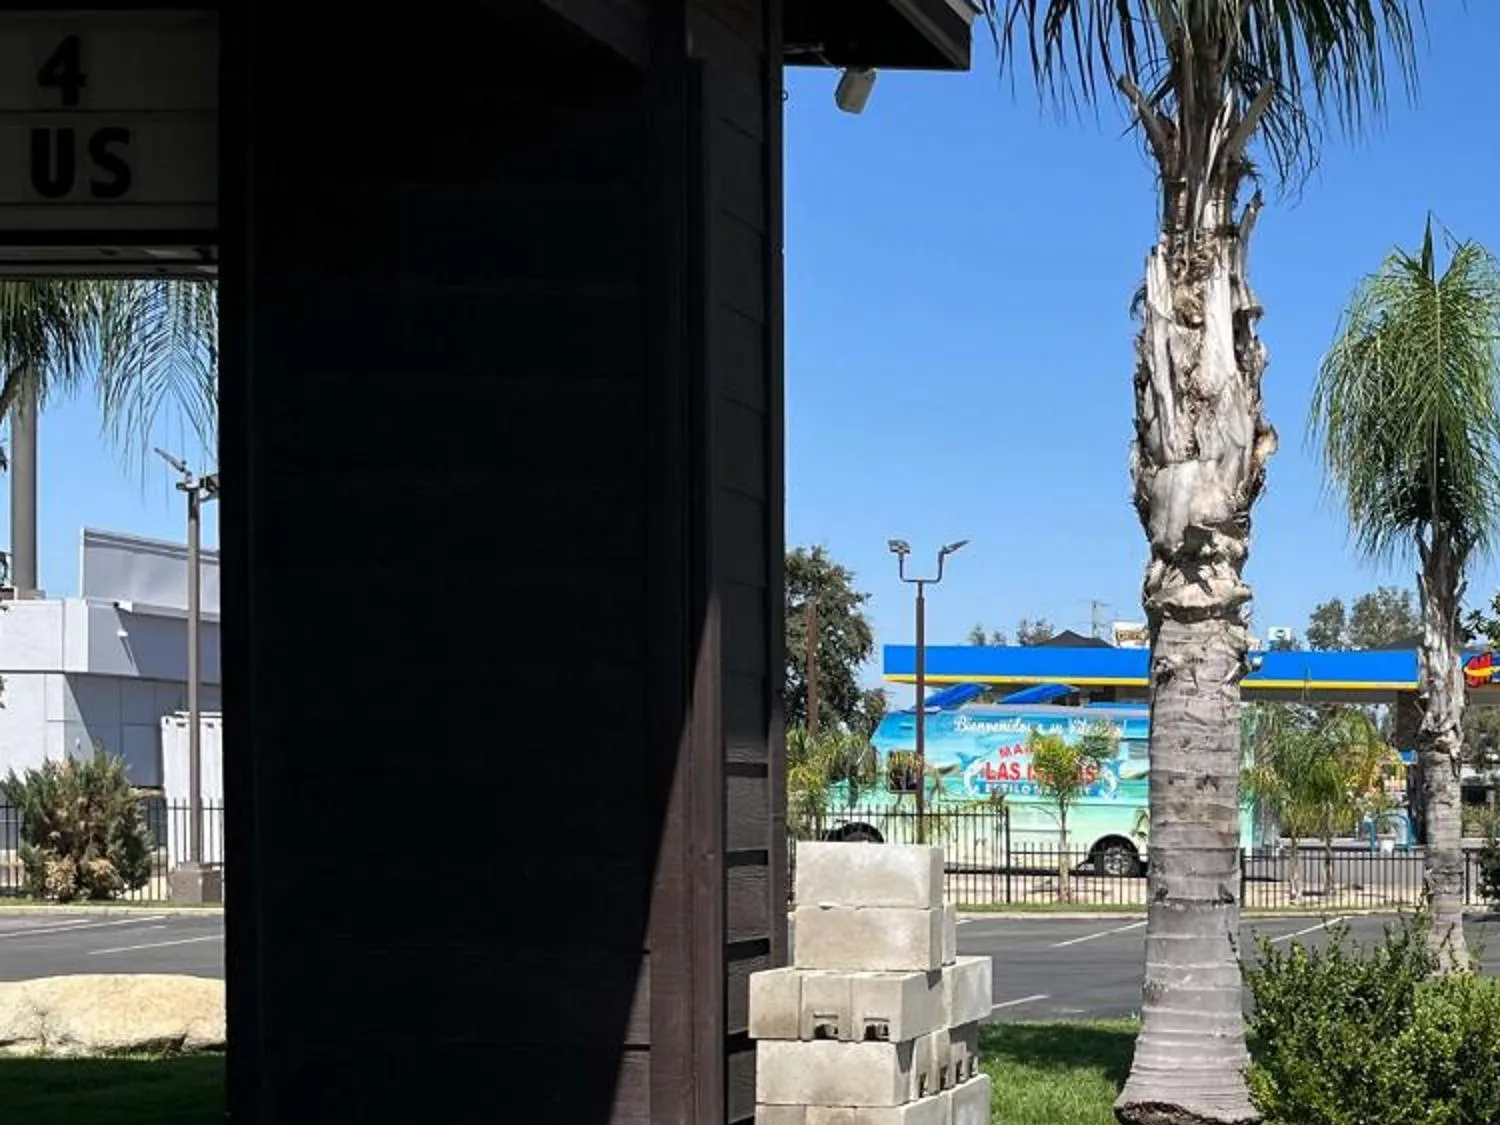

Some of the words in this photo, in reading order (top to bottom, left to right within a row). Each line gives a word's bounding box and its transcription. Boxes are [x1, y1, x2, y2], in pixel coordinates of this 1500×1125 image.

[36, 34, 88, 106] 4
[31, 126, 132, 199] US
[985, 762, 1021, 781] LAS
